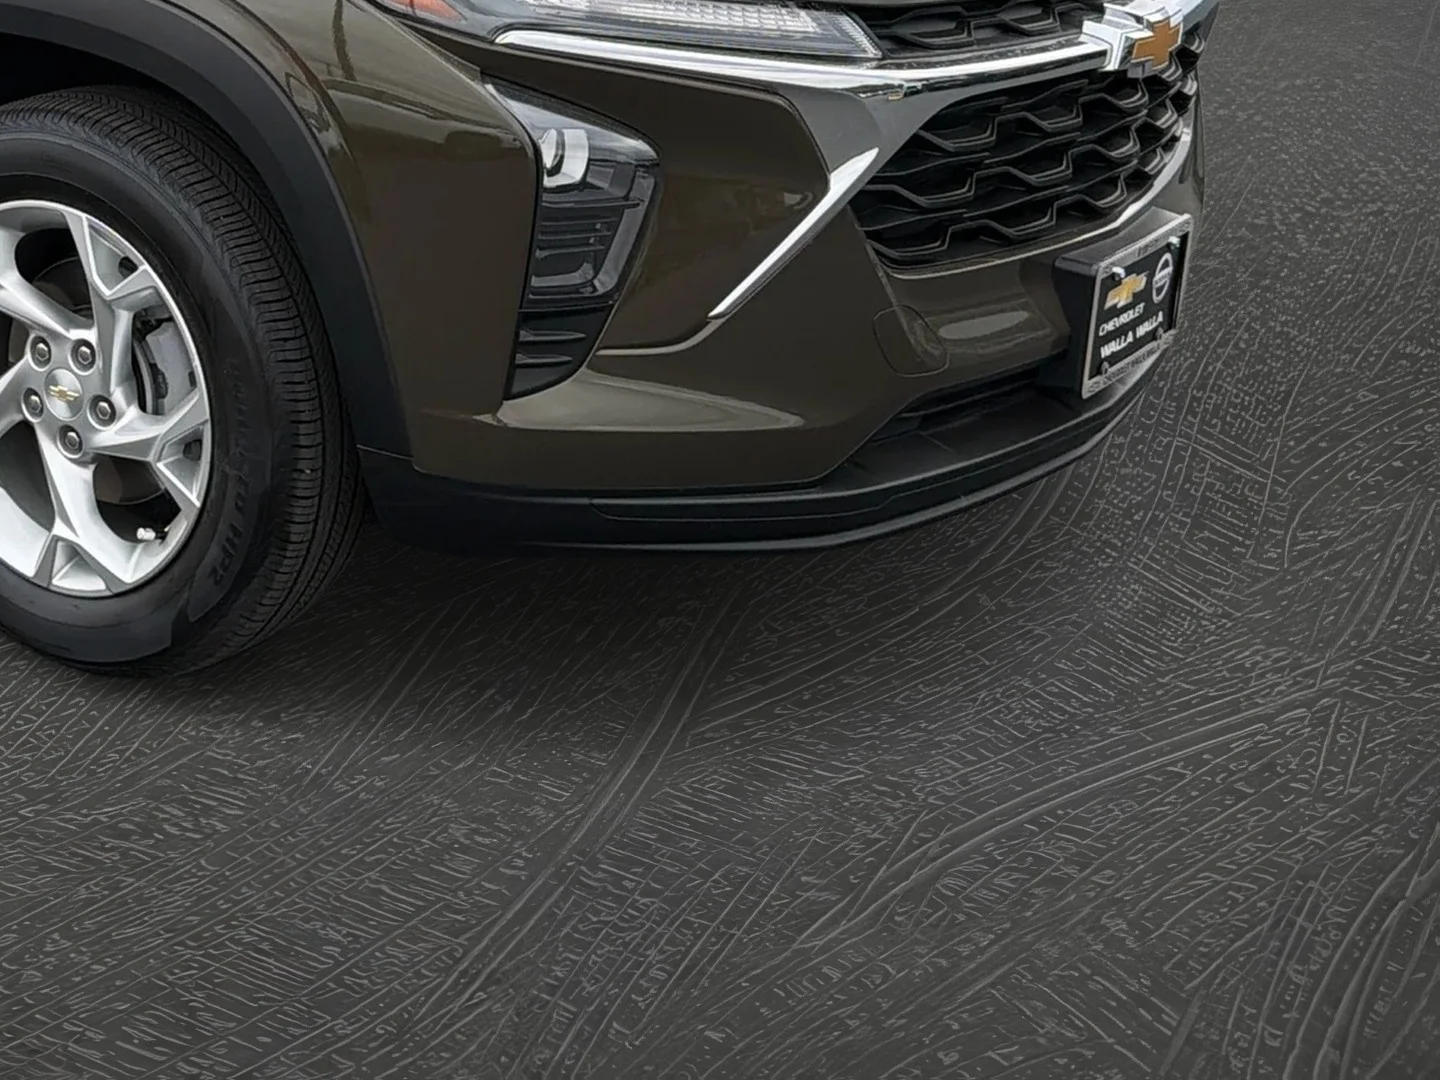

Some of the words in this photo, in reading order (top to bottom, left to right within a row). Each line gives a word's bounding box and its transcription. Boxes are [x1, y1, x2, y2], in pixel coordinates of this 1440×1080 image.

[1098, 302, 1145, 337] CHEVROLET
[1100, 330, 1134, 359] WALLA
[1135, 310, 1164, 339] WALLA
